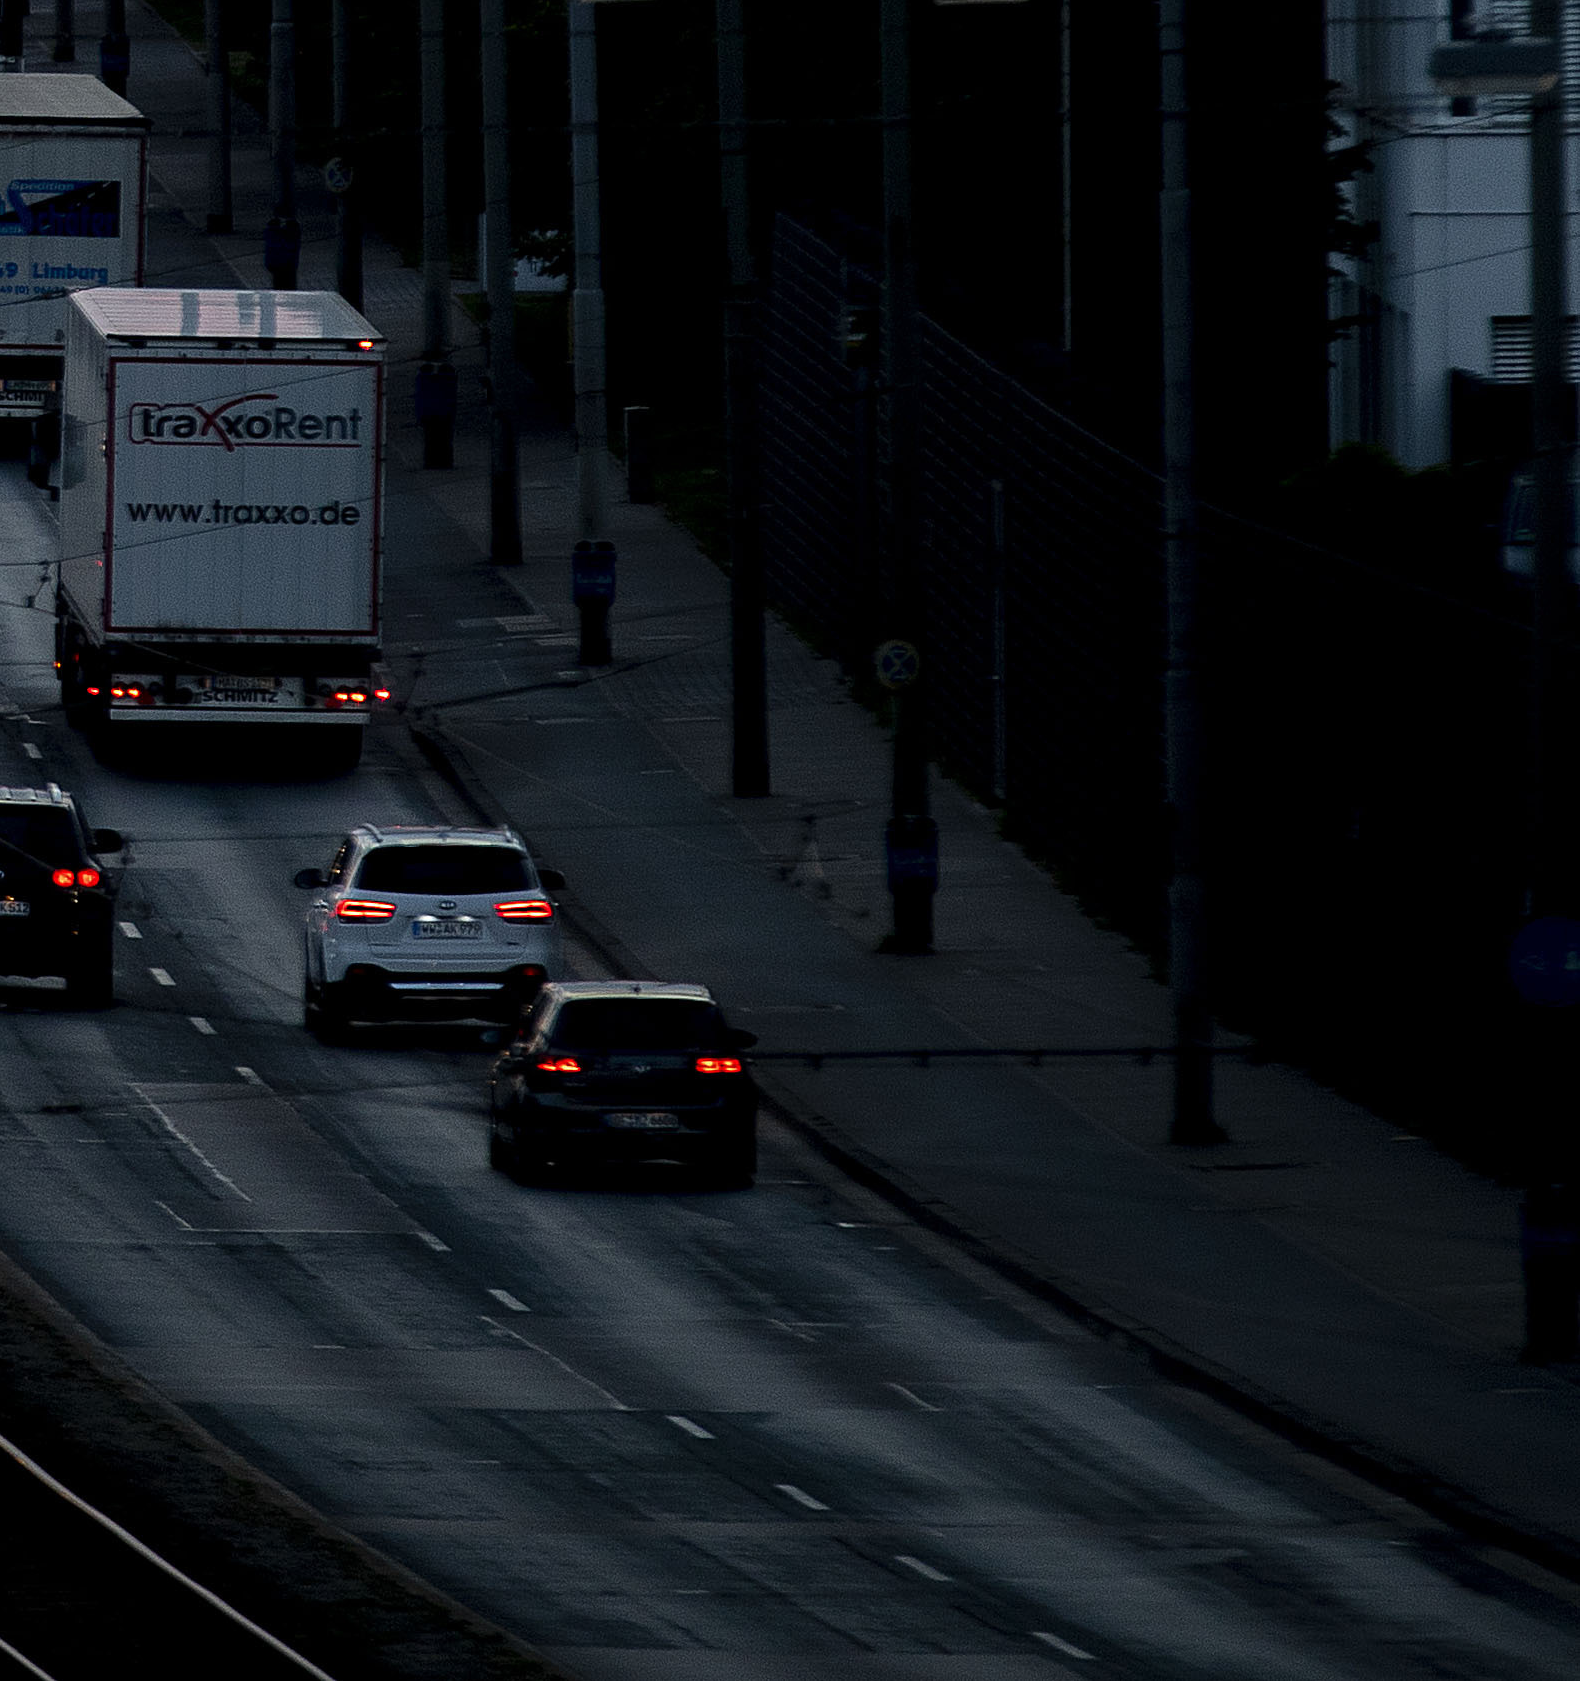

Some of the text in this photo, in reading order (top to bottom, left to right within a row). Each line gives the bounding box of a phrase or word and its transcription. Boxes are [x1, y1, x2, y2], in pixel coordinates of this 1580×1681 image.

[32, 263, 109, 285] Limburg
[127, 499, 361, 525] www.traxxo.de
[202, 690, 279, 703] SCHMITZ
